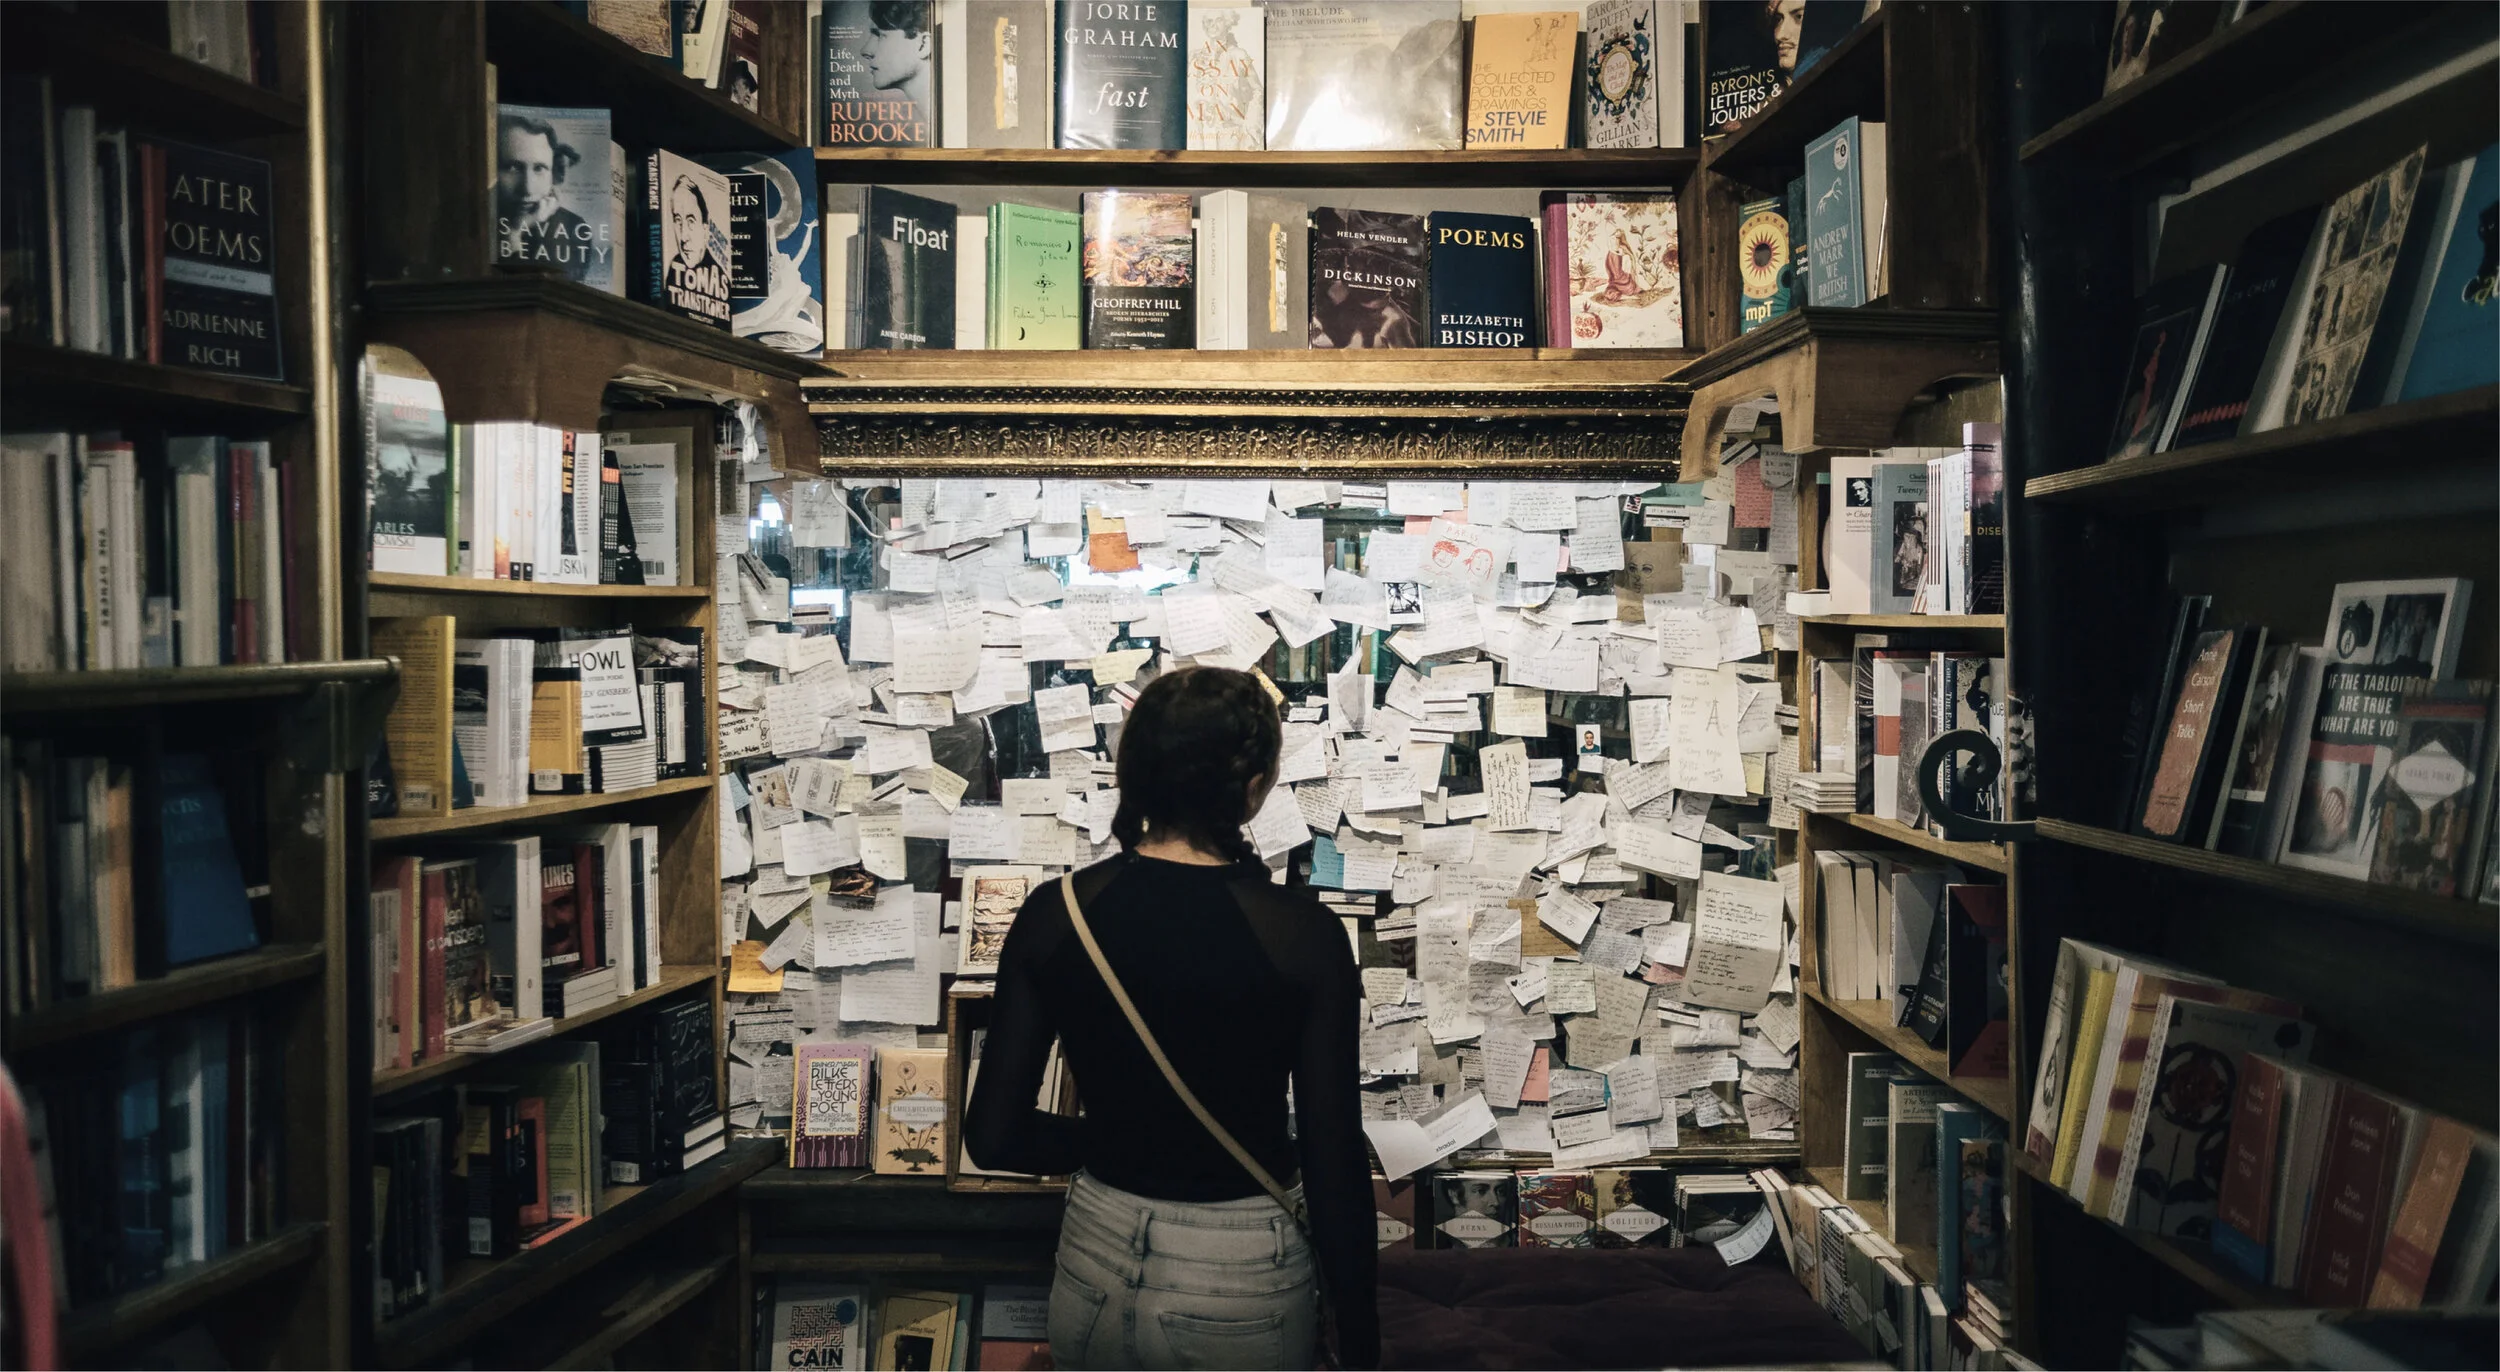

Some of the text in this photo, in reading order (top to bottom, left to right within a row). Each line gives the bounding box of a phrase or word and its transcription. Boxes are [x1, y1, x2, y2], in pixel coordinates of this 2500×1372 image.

[1087, 3, 1157, 22] JORIE
[1292, 7, 1345, 17] PRELUDE
[1600, 7, 1632, 29] DUFFY
[1306, 17, 1368, 25] WORDSWORTH
[1064, 28, 1178, 49] GRAHAM
[829, 48, 855, 60] Life,
[829, 61, 865, 73] Death
[1188, 59, 1254, 78] SSAY
[1474, 64, 1492, 72] THE
[829, 75, 851, 86] and
[1472, 71, 1555, 85] COLLECTED
[1711, 69, 1775, 95] BYRON'S
[829, 88, 859, 101] Myth
[1089, 82, 1149, 115] fast
[1471, 85, 1537, 97] POEMS &
[1710, 83, 1782, 110] LETTERS &
[831, 101, 917, 121] RUPERT
[1470, 98, 1547, 111] DRAWINGS
[1484, 111, 1547, 126] STEVIE
[1709, 102, 1768, 126] JOURN
[830, 122, 924, 142] BROOKE
[1465, 128, 1525, 143] SMITH
[1596, 120, 1641, 144] GILLIAN
[172, 174, 259, 216] ATER
[730, 195, 759, 206] GHTS
[499, 217, 610, 241] SAVAGE
[893, 216, 949, 251] Float
[1337, 230, 1408, 245] HELEN VENDLER
[1439, 228, 1525, 250] POEMS
[1813, 224, 1849, 253] ANDREW
[500, 240, 609, 264] BEAUTY
[1818, 244, 1844, 265] MARR
[1324, 269, 1417, 289] DICKINSON
[1826, 262, 1838, 279] WE
[671, 261, 730, 302] TOMAS
[1818, 275, 1847, 299] BRITISH
[1094, 298, 1182, 310] GEOFFREY HILL
[1745, 300, 1774, 323] mpT
[1441, 314, 1524, 328] ELIZABETH
[880, 329, 927, 344] ANNE CARSON
[1441, 330, 1525, 348] BISHOP
[188, 344, 241, 367] RICH
[1897, 486, 1923, 496] Twenty
[374, 521, 416, 535] ARLES
[1977, 526, 2002, 536] DISE
[569, 650, 626, 671] HOWL
[2328, 674, 2339, 689] IF
[2340, 673, 2360, 690] THE
[2338, 696, 2393, 714] ARE TRUE
[2176, 724, 2195, 739] Talks
[2320, 716, 2351, 733] WHAT
[2352, 718, 2375, 735] ARE
[543, 864, 575, 888] LINES
[812, 1068, 848, 1079] RILKE
[811, 1078, 857, 1091] LETTERS
[818, 1090, 857, 1102] YOUNG
[810, 1100, 847, 1115] POET
[1460, 1224, 1488, 1232] BURNS
[1610, 1217, 1656, 1225] SOLITUDE
[1386, 1226, 1404, 1234] KE
[1006, 1304, 1018, 1313] The
[1019, 1304, 1035, 1314] Blue
[788, 1348, 843, 1367] CAIN
